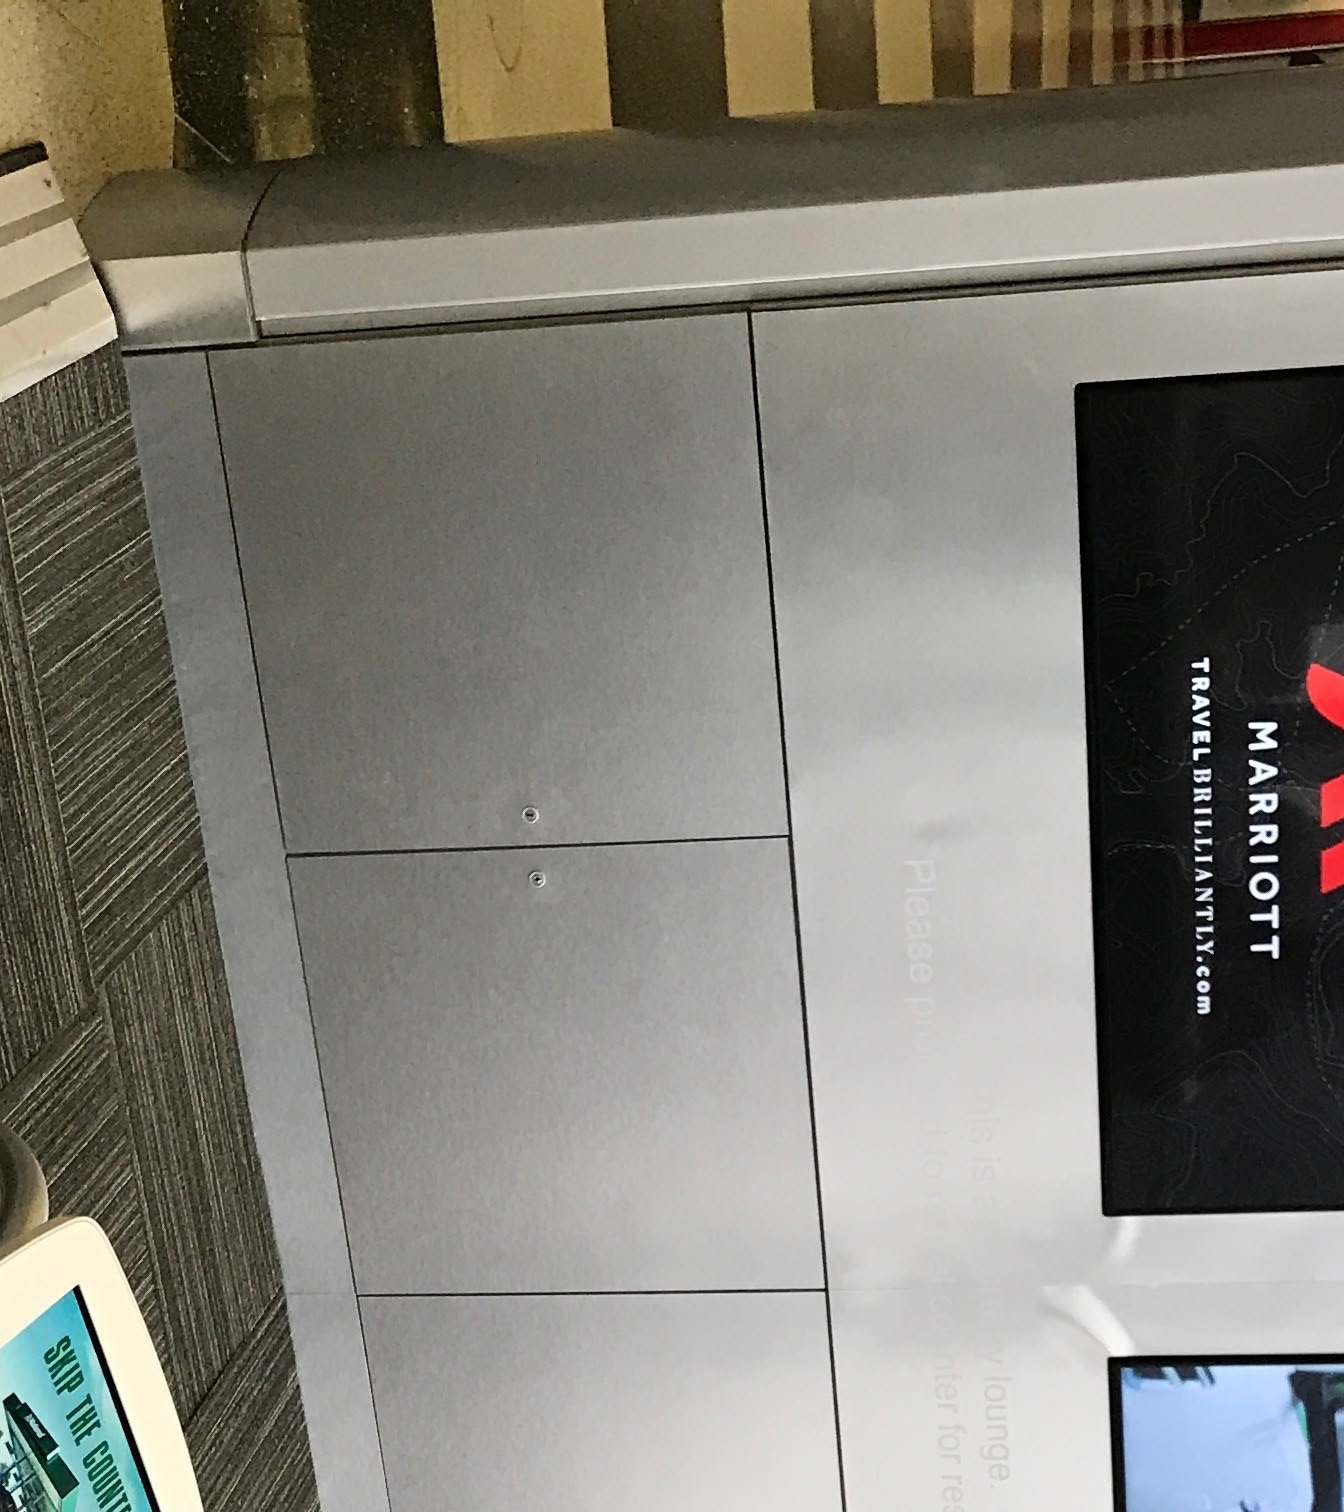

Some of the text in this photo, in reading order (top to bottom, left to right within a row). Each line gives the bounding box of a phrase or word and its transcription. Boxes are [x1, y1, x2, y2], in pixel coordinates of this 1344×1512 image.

[1247, 720, 1281, 960] MARRIOTT
[903, 859, 938, 985] Please
[43, 1335, 85, 1395] SKIP
[64, 1393, 102, 1447] THE
[929, 1295, 962, 1414] conter
[937, 1423, 967, 1465] for
[979, 1375, 1013, 1489] lounge.
